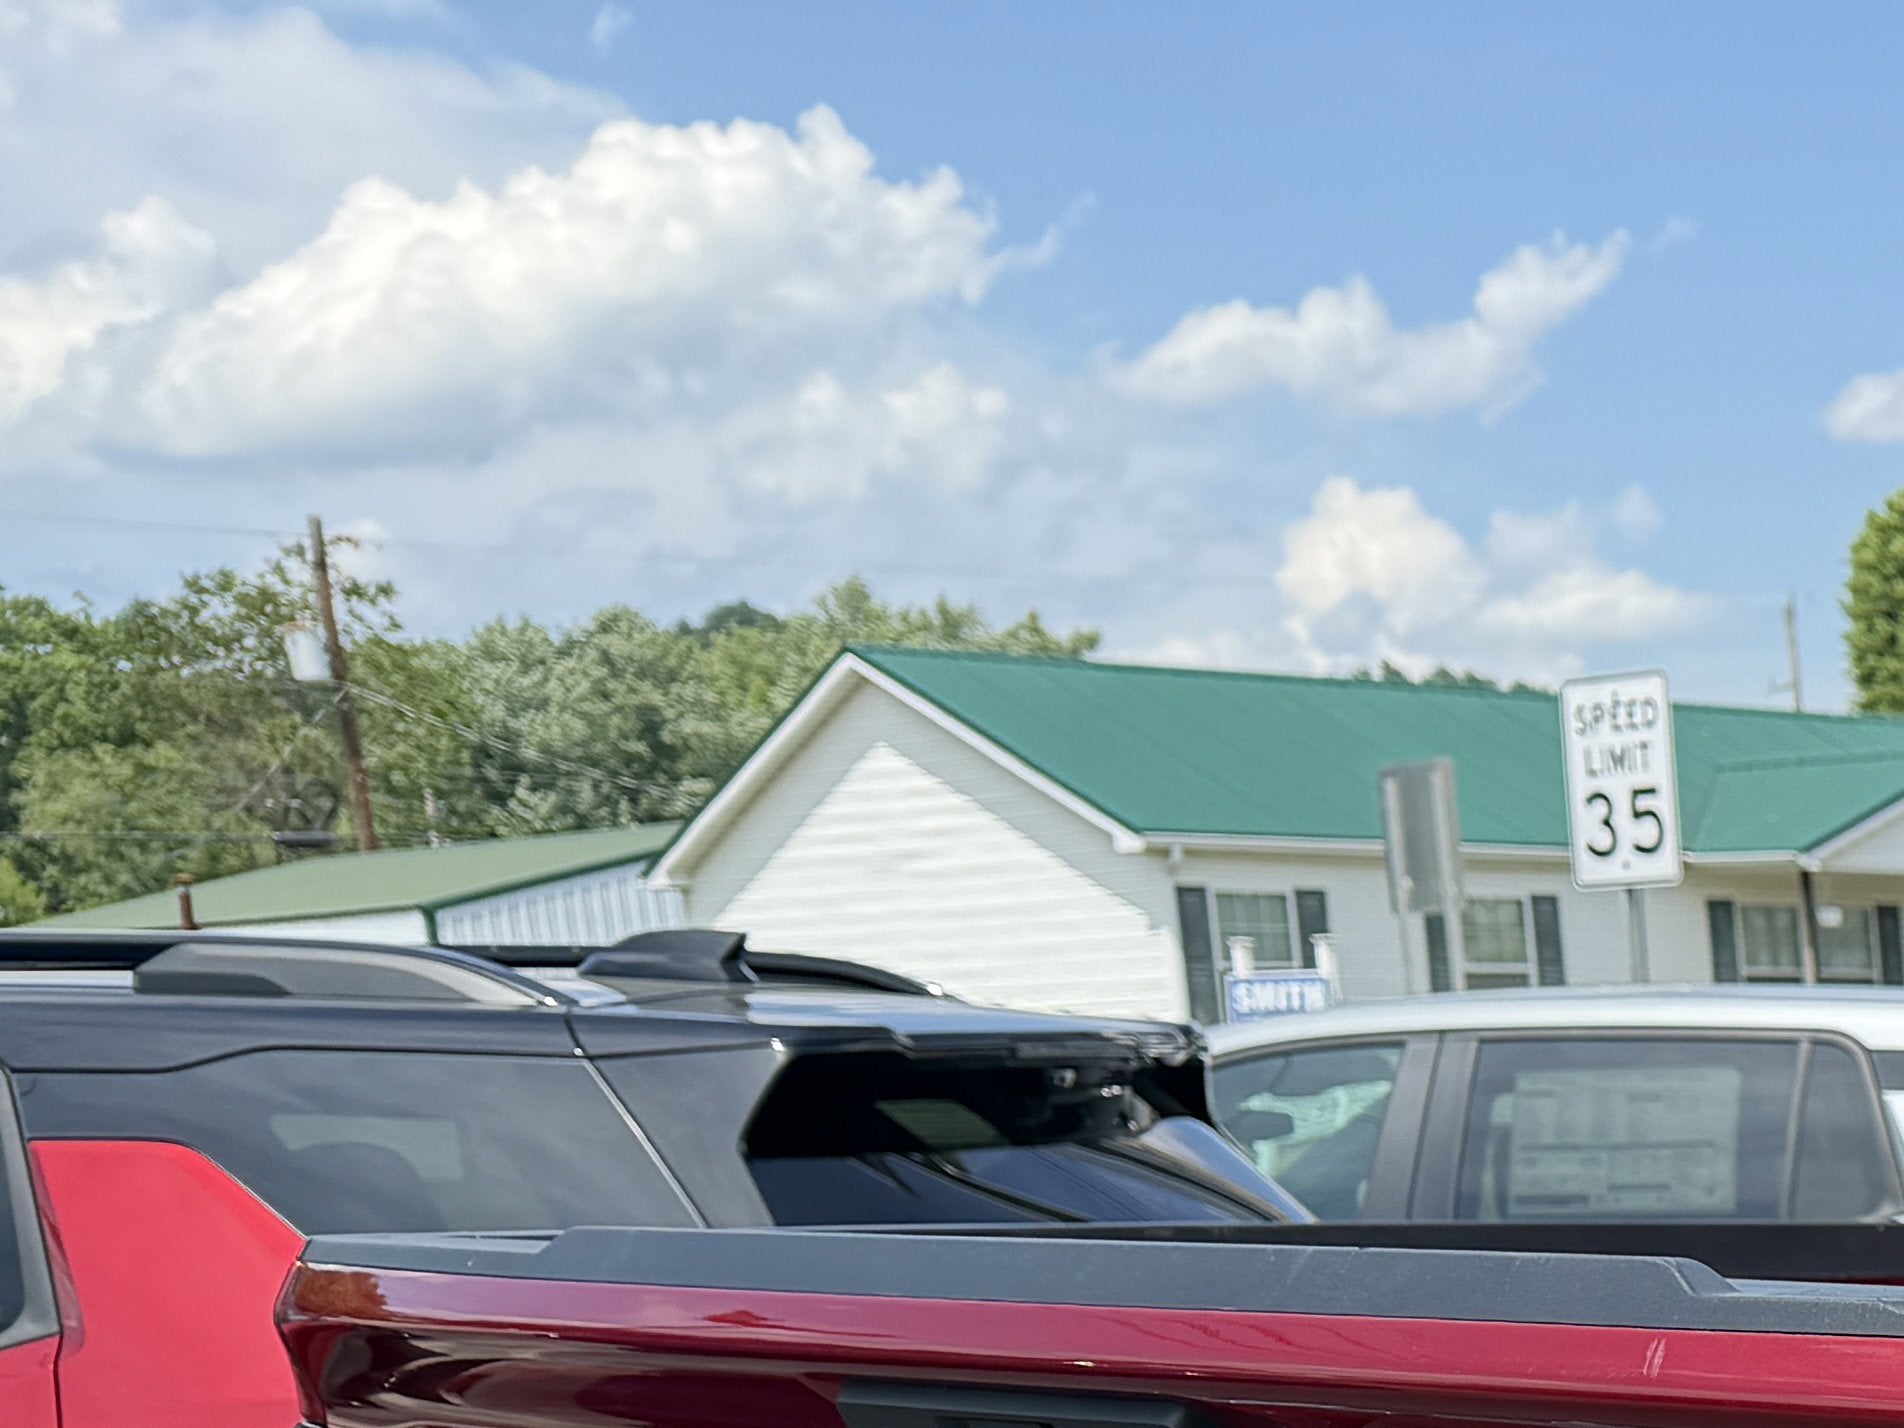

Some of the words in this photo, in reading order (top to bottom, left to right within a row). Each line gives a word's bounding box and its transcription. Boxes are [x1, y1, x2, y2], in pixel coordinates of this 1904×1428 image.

[1573, 696, 1660, 737] SPEED
[1582, 740, 1651, 778] LIMIT
[1585, 787, 1664, 858] 35
[1231, 981, 1327, 1014] SMITH
